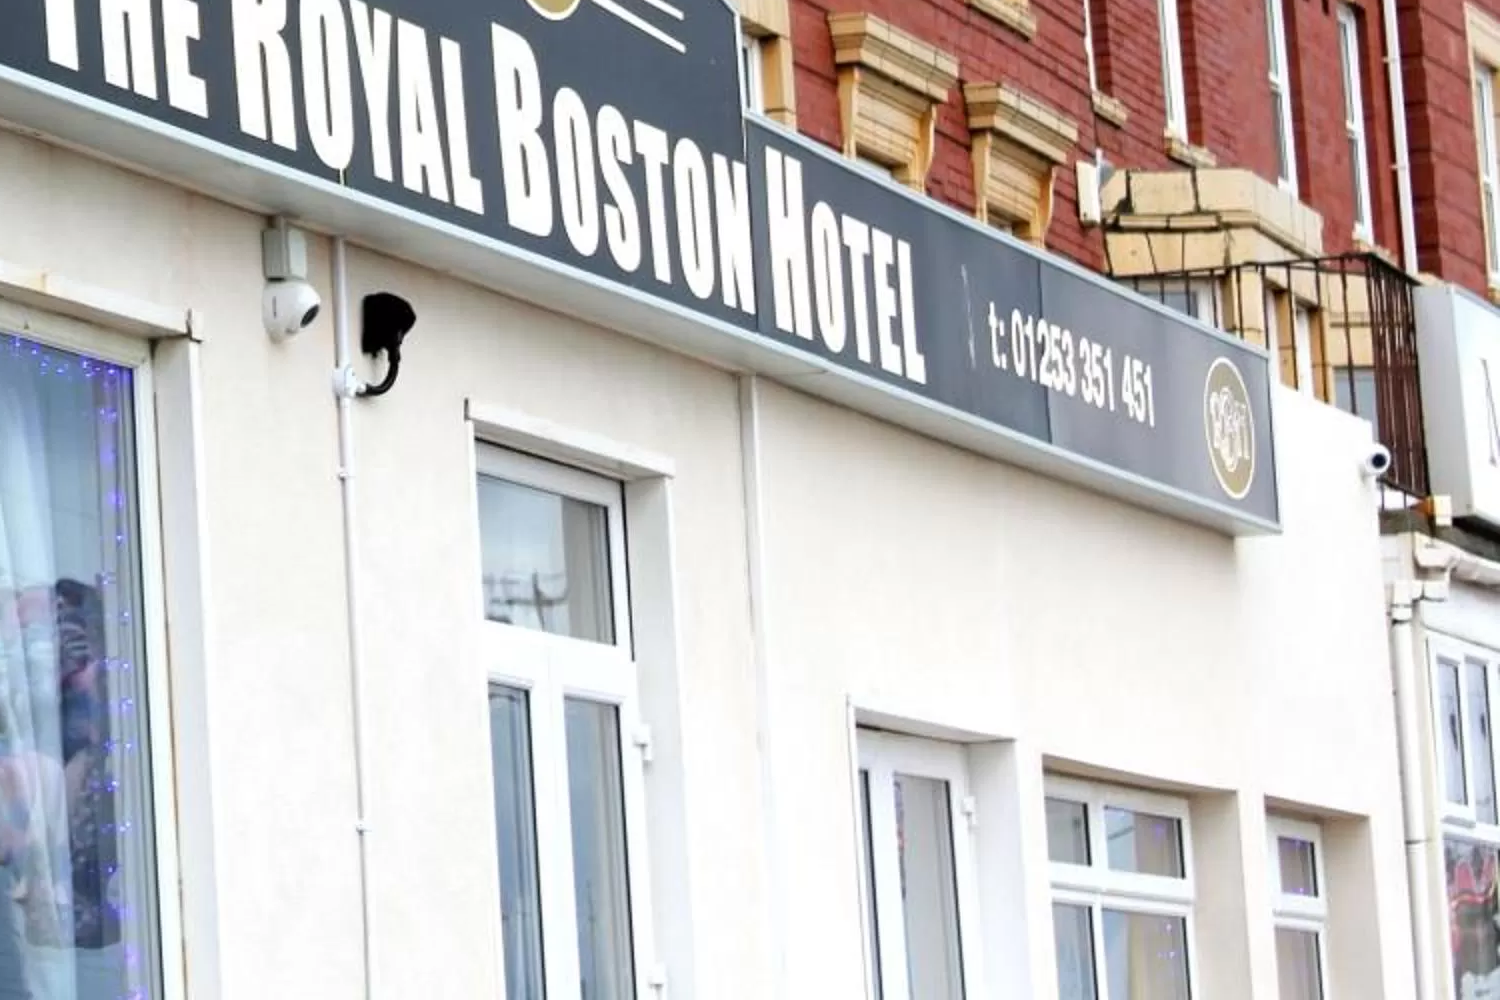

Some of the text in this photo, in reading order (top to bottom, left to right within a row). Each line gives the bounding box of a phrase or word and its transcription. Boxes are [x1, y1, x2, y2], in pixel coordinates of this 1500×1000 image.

[491, 22, 756, 314] BOSTON
[764, 146, 926, 385] HOTEL
[1011, 308, 1076, 397] 01253
[1079, 336, 1115, 411] 351
[1122, 355, 1155, 428] 451
